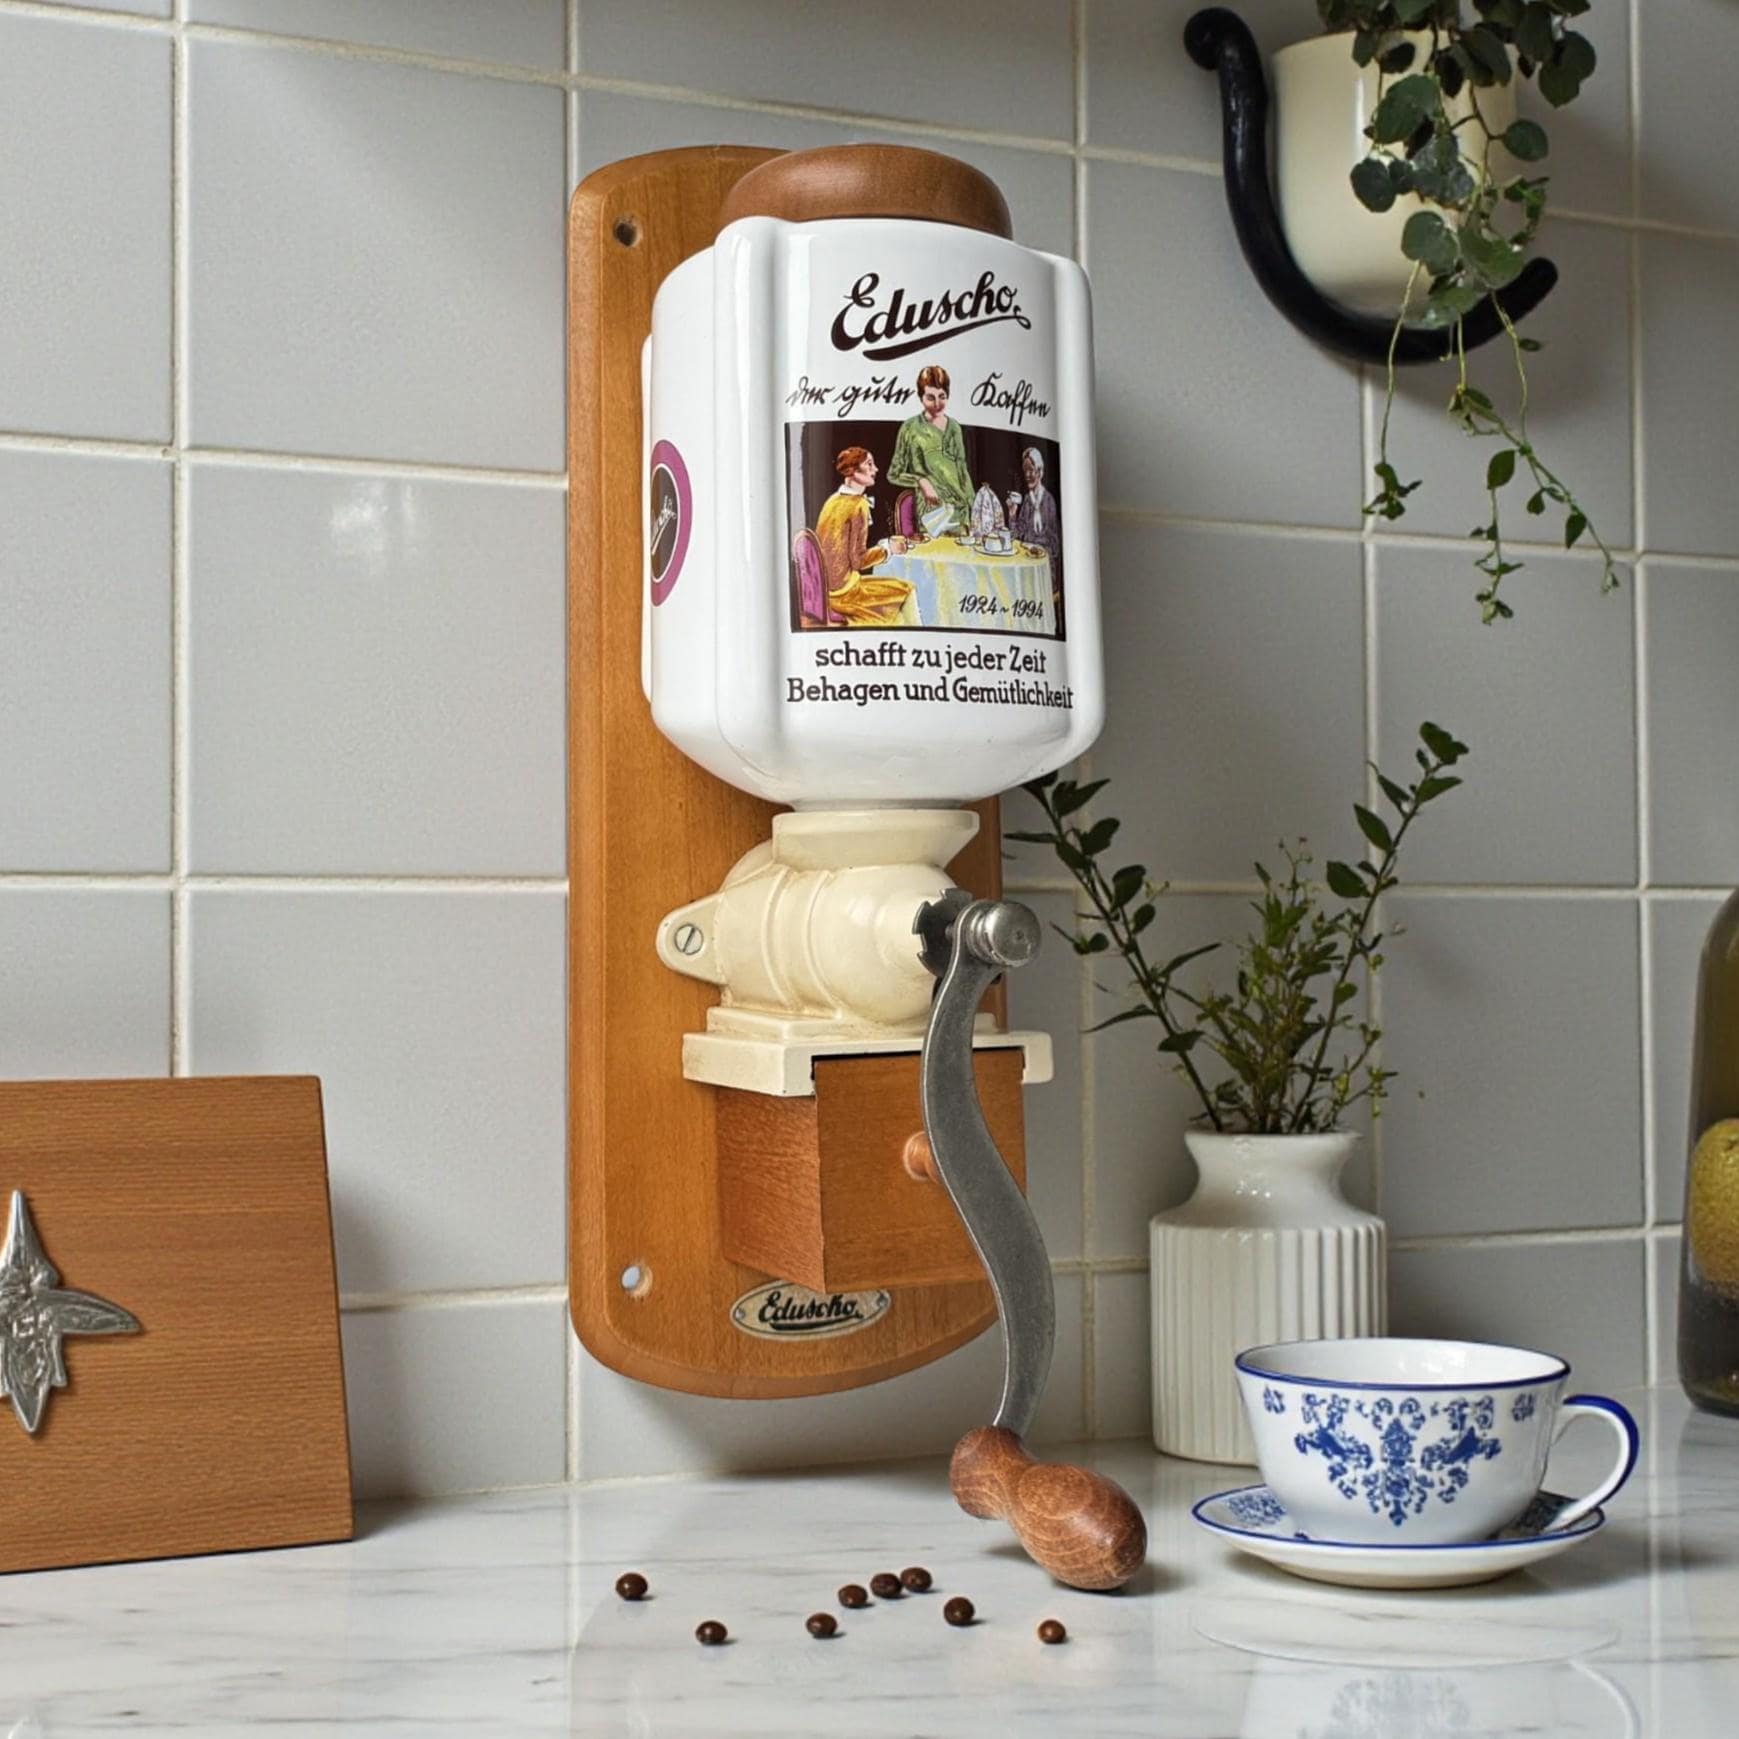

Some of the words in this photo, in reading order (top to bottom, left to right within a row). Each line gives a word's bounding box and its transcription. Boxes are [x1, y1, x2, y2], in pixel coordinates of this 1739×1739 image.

[815, 641, 907, 667] schafft
[911, 649, 942, 668] zu
[944, 645, 1005, 674] jeder
[1008, 646, 1047, 674] Zeit
[786, 676, 900, 706] Behagen
[903, 677, 950, 702] und
[952, 676, 1074, 709] Gemütlichkeit
